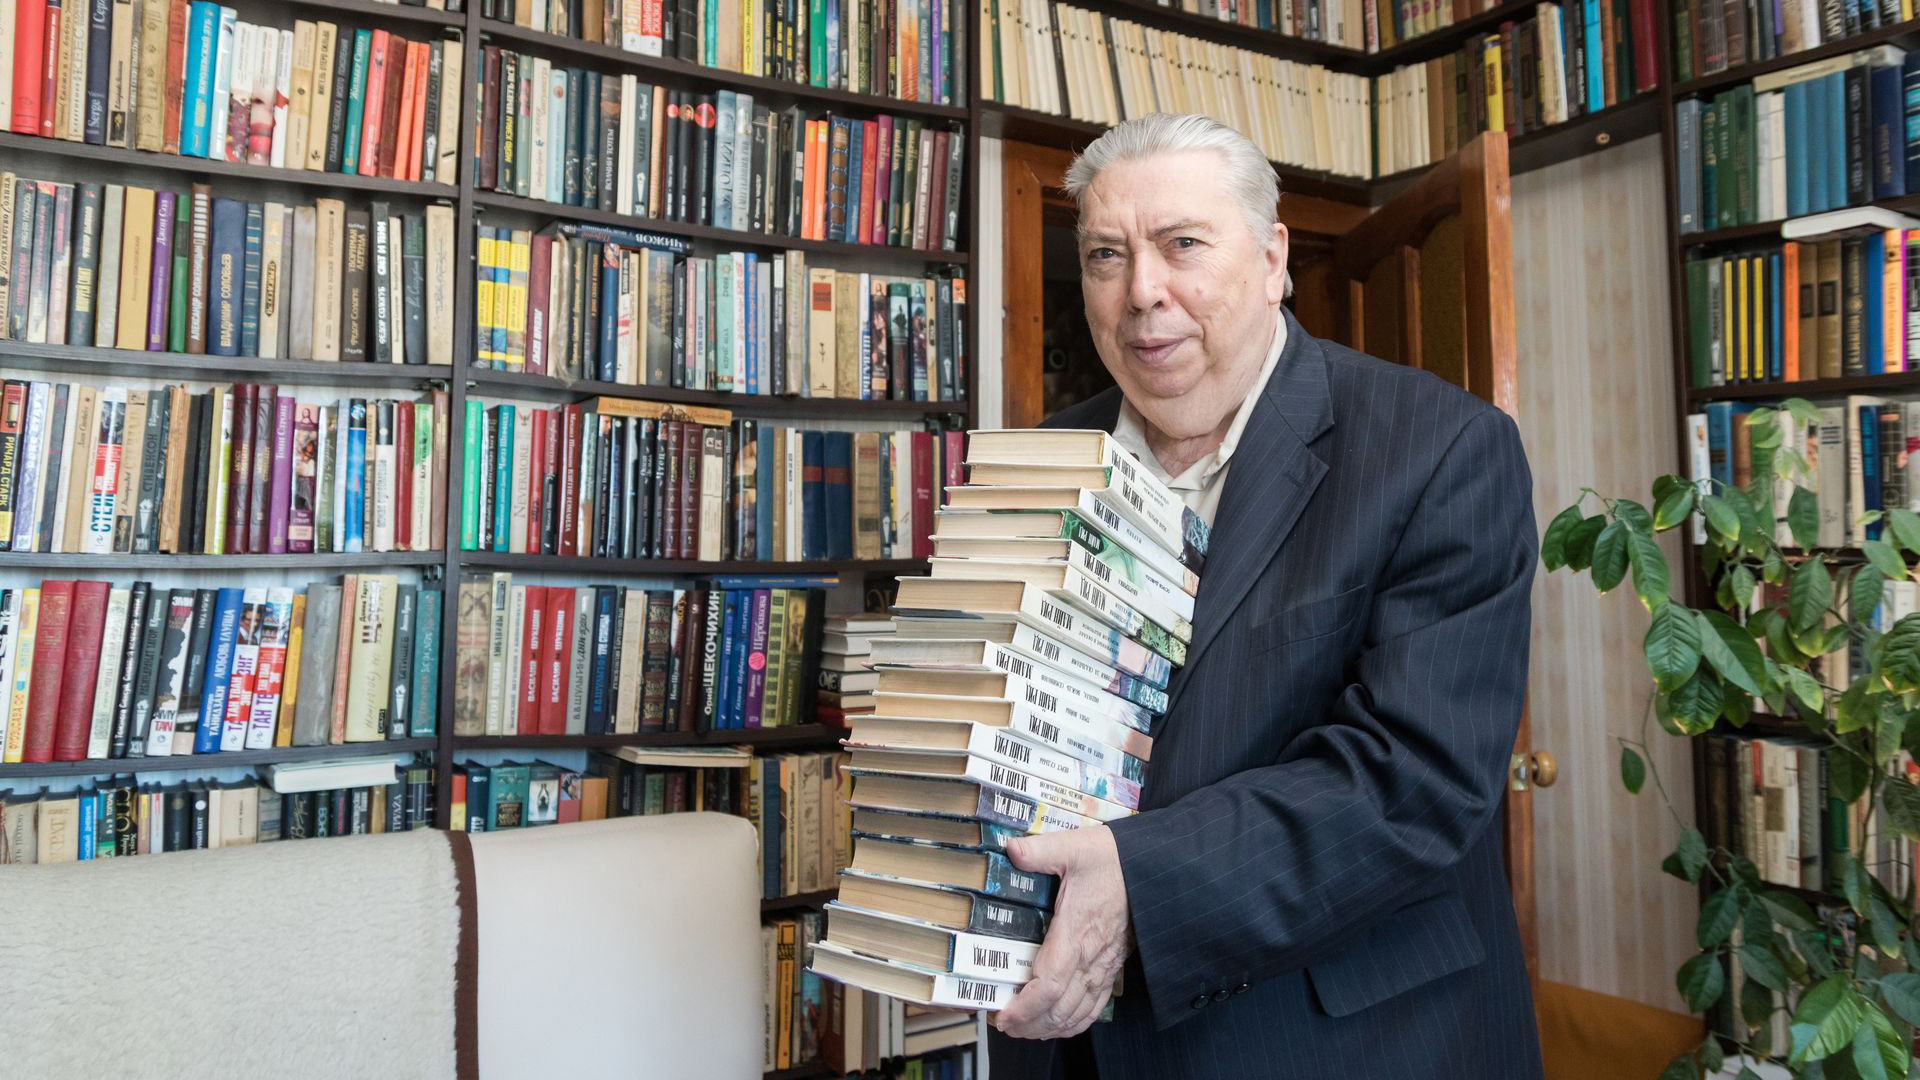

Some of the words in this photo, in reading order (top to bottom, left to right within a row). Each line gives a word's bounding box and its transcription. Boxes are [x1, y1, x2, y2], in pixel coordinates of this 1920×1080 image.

[606, 129, 614, 155] ТОТЕМ
[948, 167, 959, 205] ЧЕХОВ
[159, 199, 168, 217] Сол
[157, 219, 167, 245] Джон
[377, 221, 386, 245] ТЕНИ
[192, 245, 204, 296] СОЛЖЕНИЦЫН
[221, 253, 232, 298] СОЛОВЬЕВ
[377, 255, 386, 275] СВЕТ
[378, 286, 386, 319] СОЛОГУБ
[190, 298, 203, 340] АЛЕКСАНДР
[220, 301, 234, 347] ВЛАДИМИР
[2, 436, 15, 474] РИЧАРД
[142, 434, 157, 492] СТИВЕНСОН
[655, 452, 666, 479] Чтец
[1111, 450, 1121, 470] РИД
[1121, 459, 1135, 482] МАЙН
[0, 477, 11, 506] СТАРК
[1122, 481, 1131, 499] РИД
[1093, 499, 1104, 516] РИД
[1131, 491, 1143, 513] МАЙН
[1105, 508, 1120, 532] МАЙН
[1078, 526, 1088, 539] РИД
[1088, 534, 1100, 550] МАЙН
[1084, 551, 1096, 569] РИД
[1096, 559, 1112, 583] МАЙН
[1080, 577, 1092, 597] РИД
[1039, 599, 1053, 621] РИД
[1092, 588, 1105, 611] МАЙН
[753, 595, 767, 650] Щербакова
[1054, 608, 1074, 630] МАЙН
[703, 590, 720, 687] ЩЕКОЧИХИН
[1032, 634, 1044, 653] РИД
[214, 643, 229, 678] ЛЮБОВЬ
[995, 650, 1011, 671] РИД
[1045, 643, 1060, 662] МАЙН
[1012, 658, 1034, 680] МАЙН
[527, 660, 536, 702] ВАСИЛИЙ
[552, 662, 560, 703] ВАСИЛИЙ
[704, 687, 713, 715] Юрий
[1025, 684, 1039, 704] РИД
[1040, 689, 1058, 713] МАЙН
[253, 709, 272, 729] ТАН
[1029, 714, 1042, 734] РИД
[993, 734, 1012, 755] РИД
[1042, 723, 1060, 744] МАЙН
[1012, 741, 1032, 764] МАЙН
[1039, 757, 1055, 768] СУДЬБЫ
[1093, 750, 1104, 760] ОХОТА
[989, 763, 1006, 783] РИД
[1057, 764, 1069, 774] ПЕРСТ
[1006, 769, 1029, 792] МАЙН
[993, 792, 1008, 816] РИД
[1007, 798, 1031, 823] МАЙН
[1010, 871, 1021, 889] РИД
[1021, 877, 1034, 892] МАЙН
[987, 905, 997, 922] РИД
[998, 908, 1013, 924] МАЙН
[972, 944, 987, 966] РИД
[989, 950, 1010, 972] МАЙН
[957, 978, 973, 999] РИД
[973, 984, 998, 1005] МАЙН
